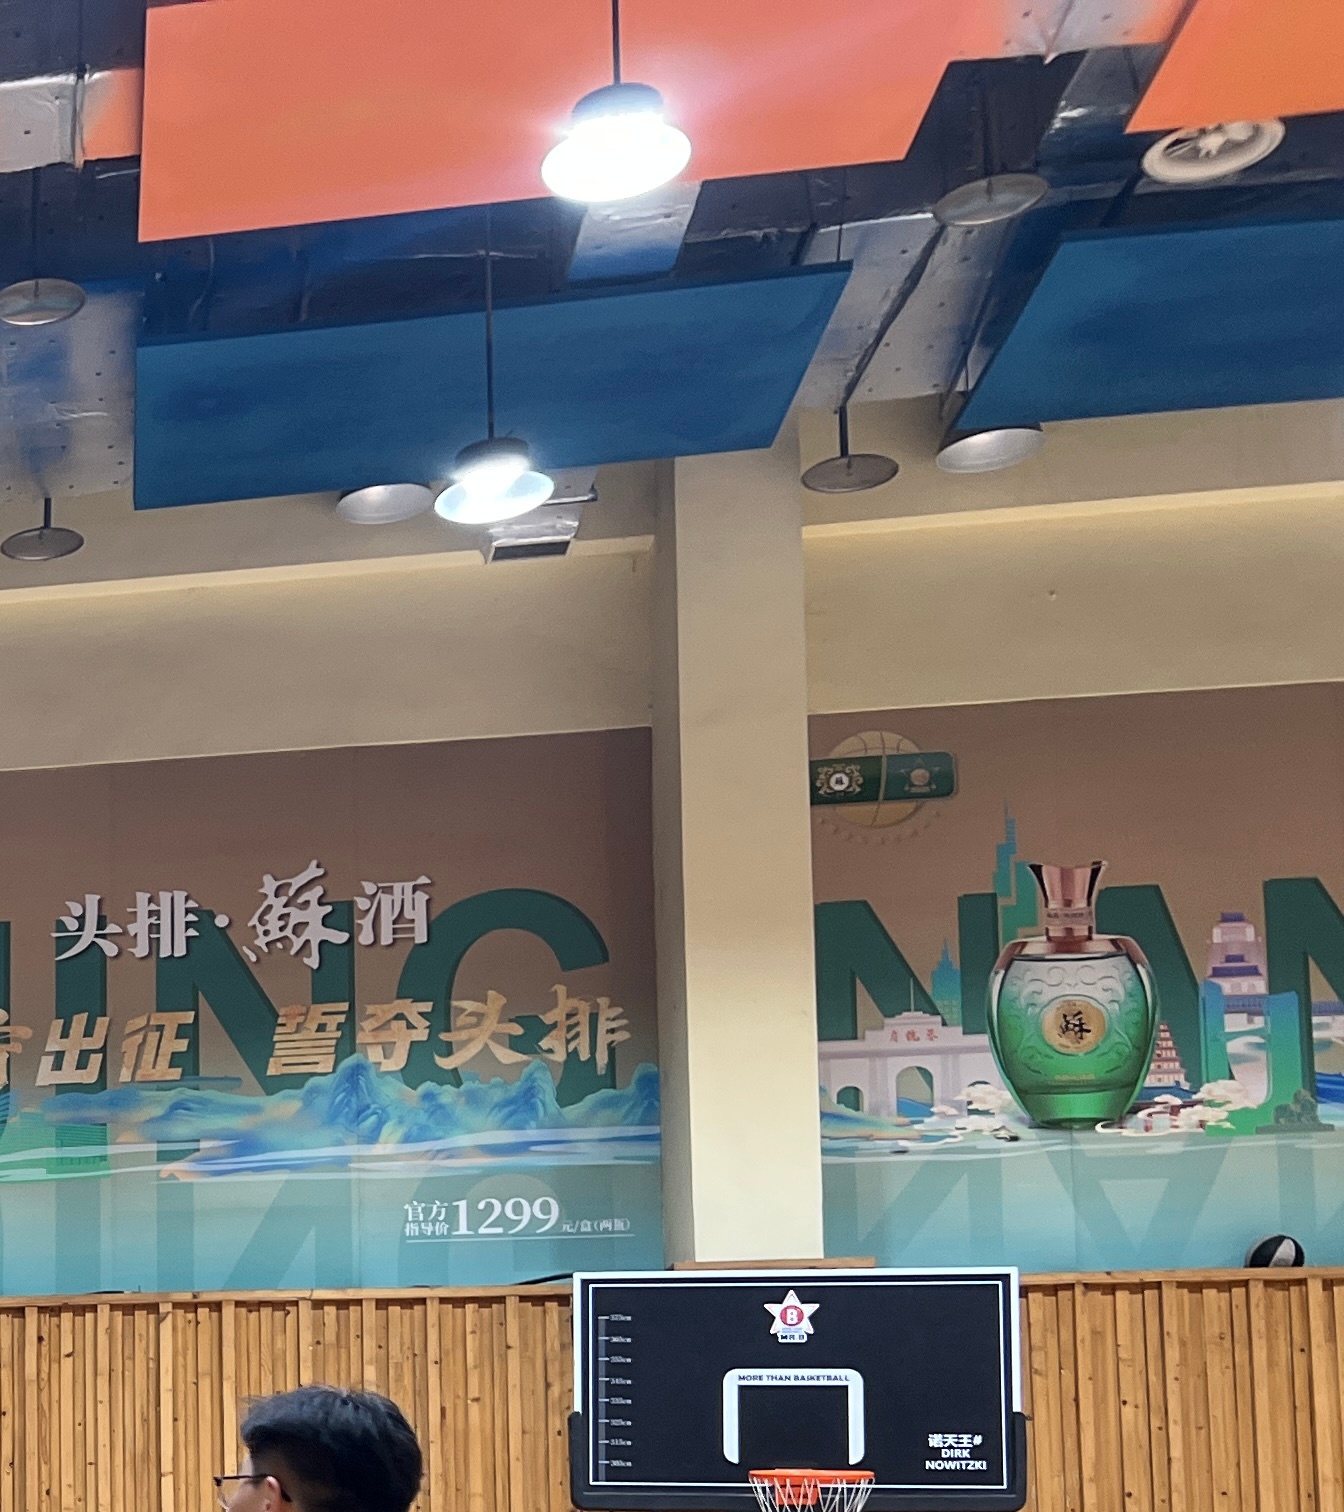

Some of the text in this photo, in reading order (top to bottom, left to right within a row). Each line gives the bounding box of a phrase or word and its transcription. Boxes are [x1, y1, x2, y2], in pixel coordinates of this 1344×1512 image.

[266, 984, 636, 1077] 誓夺头排
[403, 1200, 449, 1222] 官方
[451, 1196, 560, 1236] 1299
[786, 1308, 799, 1325] B
[738, 1374, 850, 1382] MORE THAN BASKETBALL
[941, 1448, 971, 1459] DIRK
[925, 1460, 987, 1471] NOWITZKI
